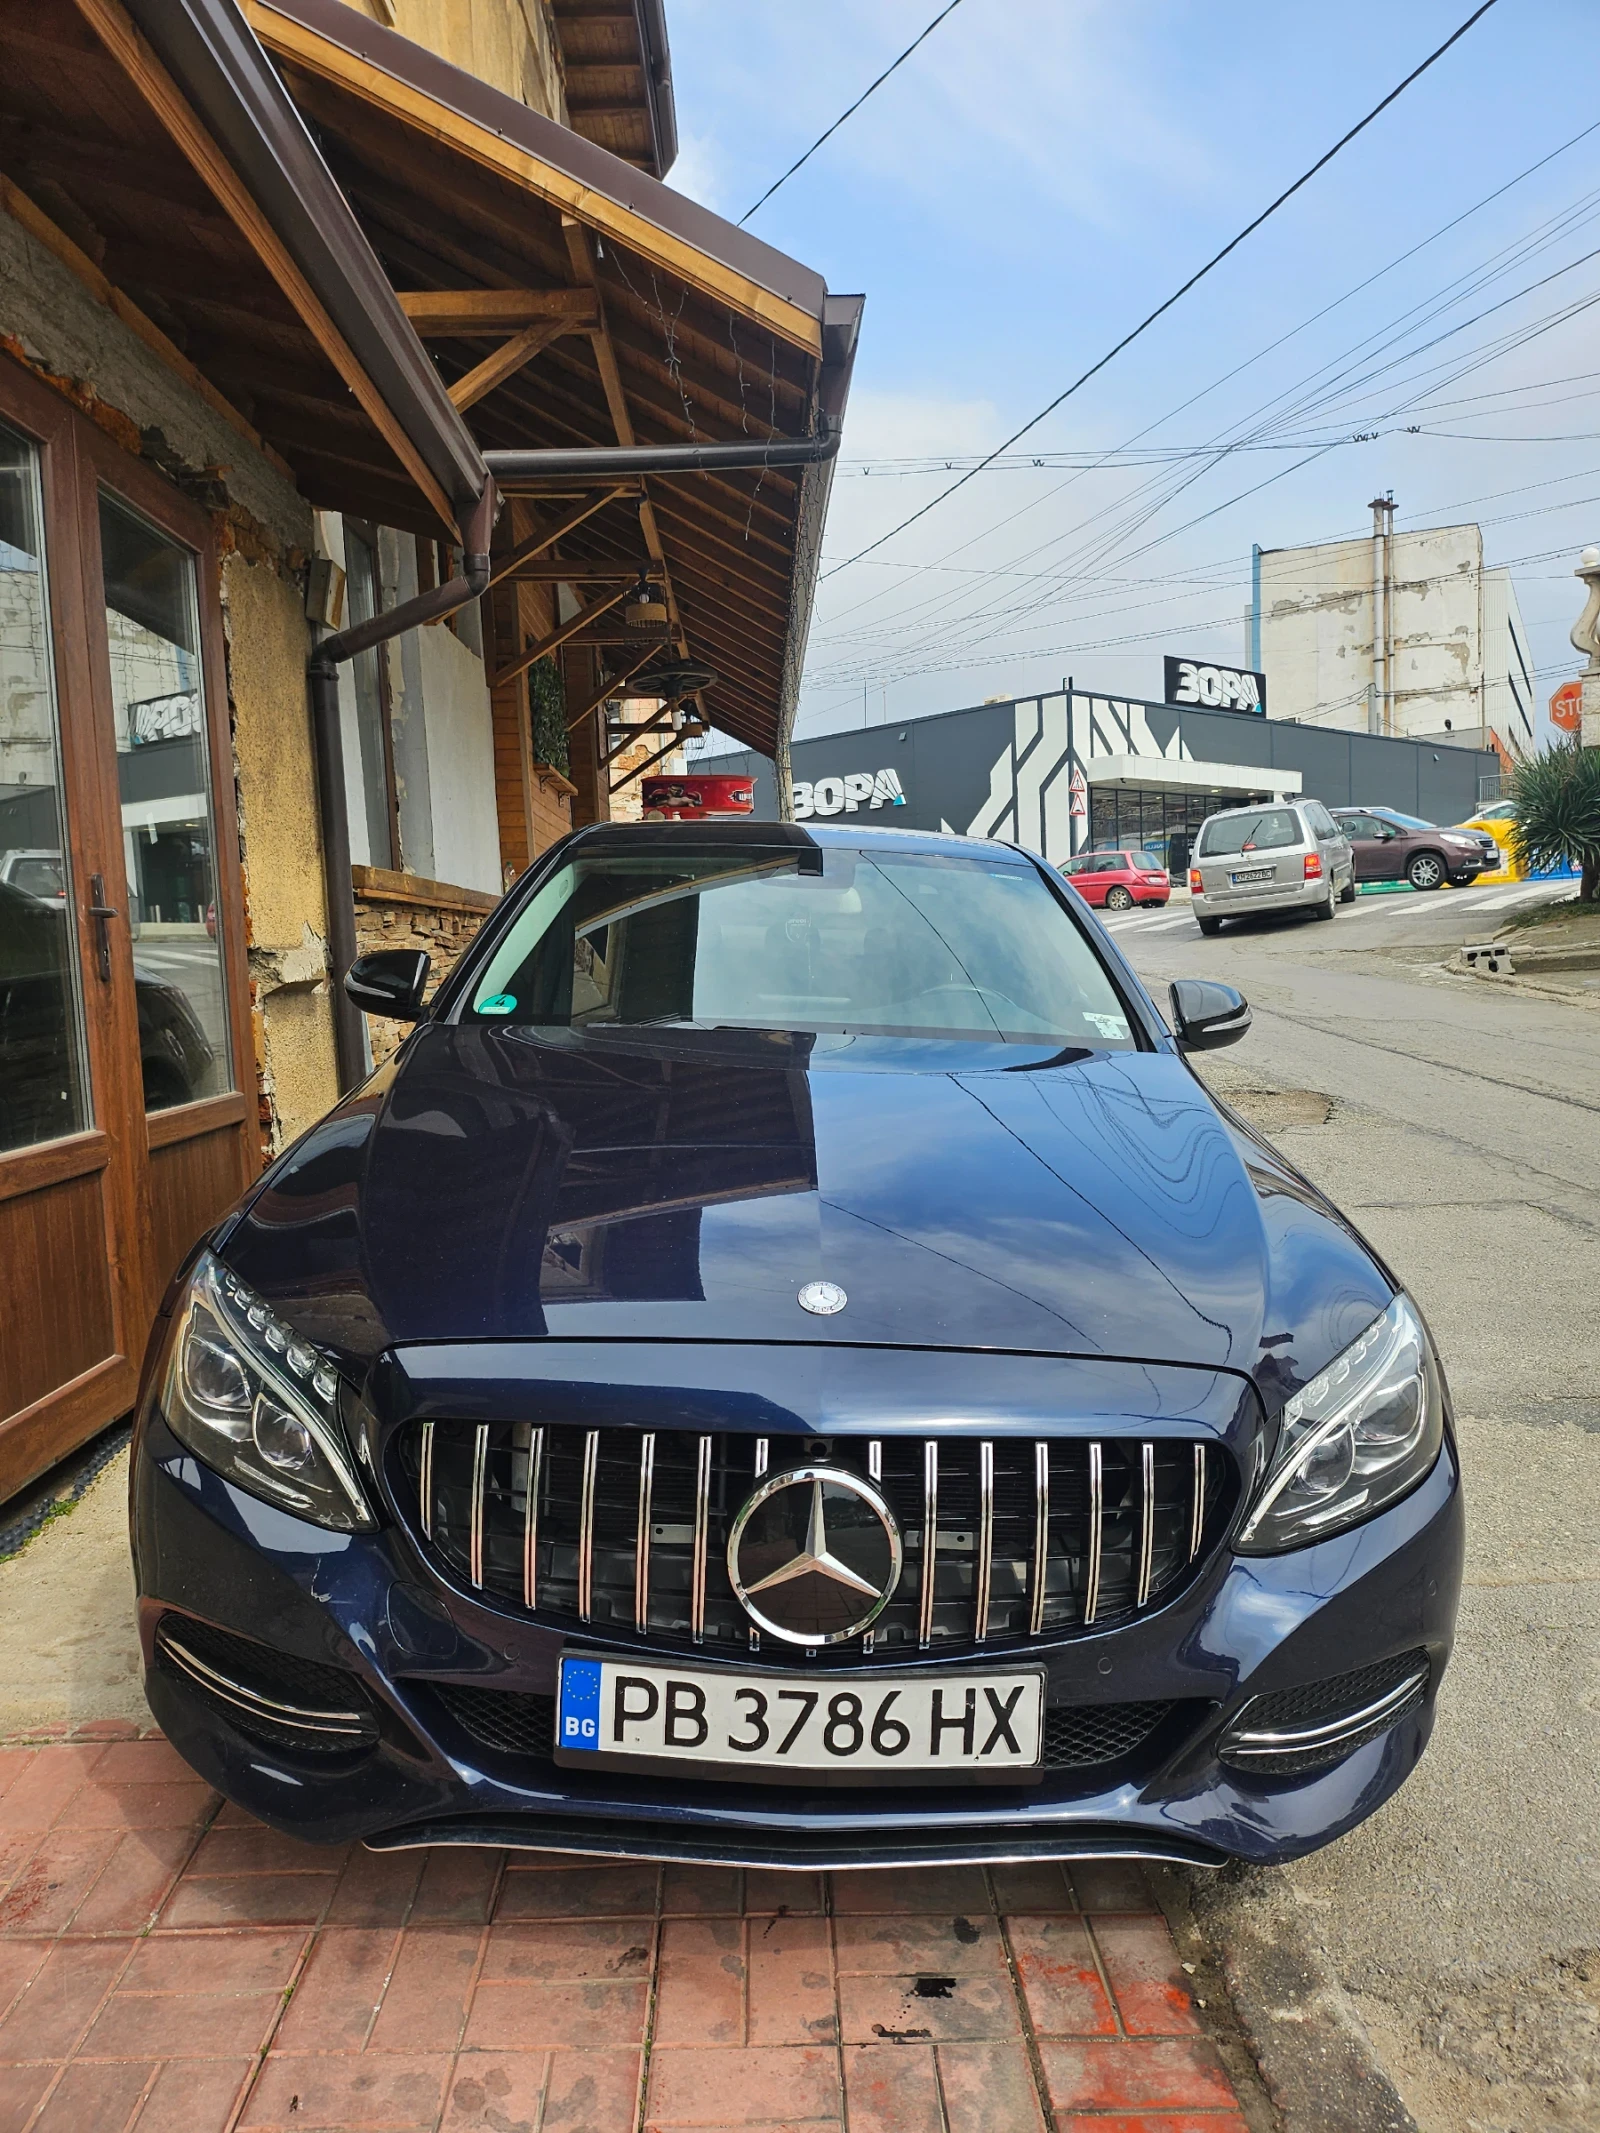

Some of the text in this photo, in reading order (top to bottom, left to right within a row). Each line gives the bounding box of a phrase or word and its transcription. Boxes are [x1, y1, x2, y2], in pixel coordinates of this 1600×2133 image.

[494, 995, 507, 1006] 4
[565, 1716, 596, 1738] BG
[613, 1675, 1025, 1757] PB 3786 HX
